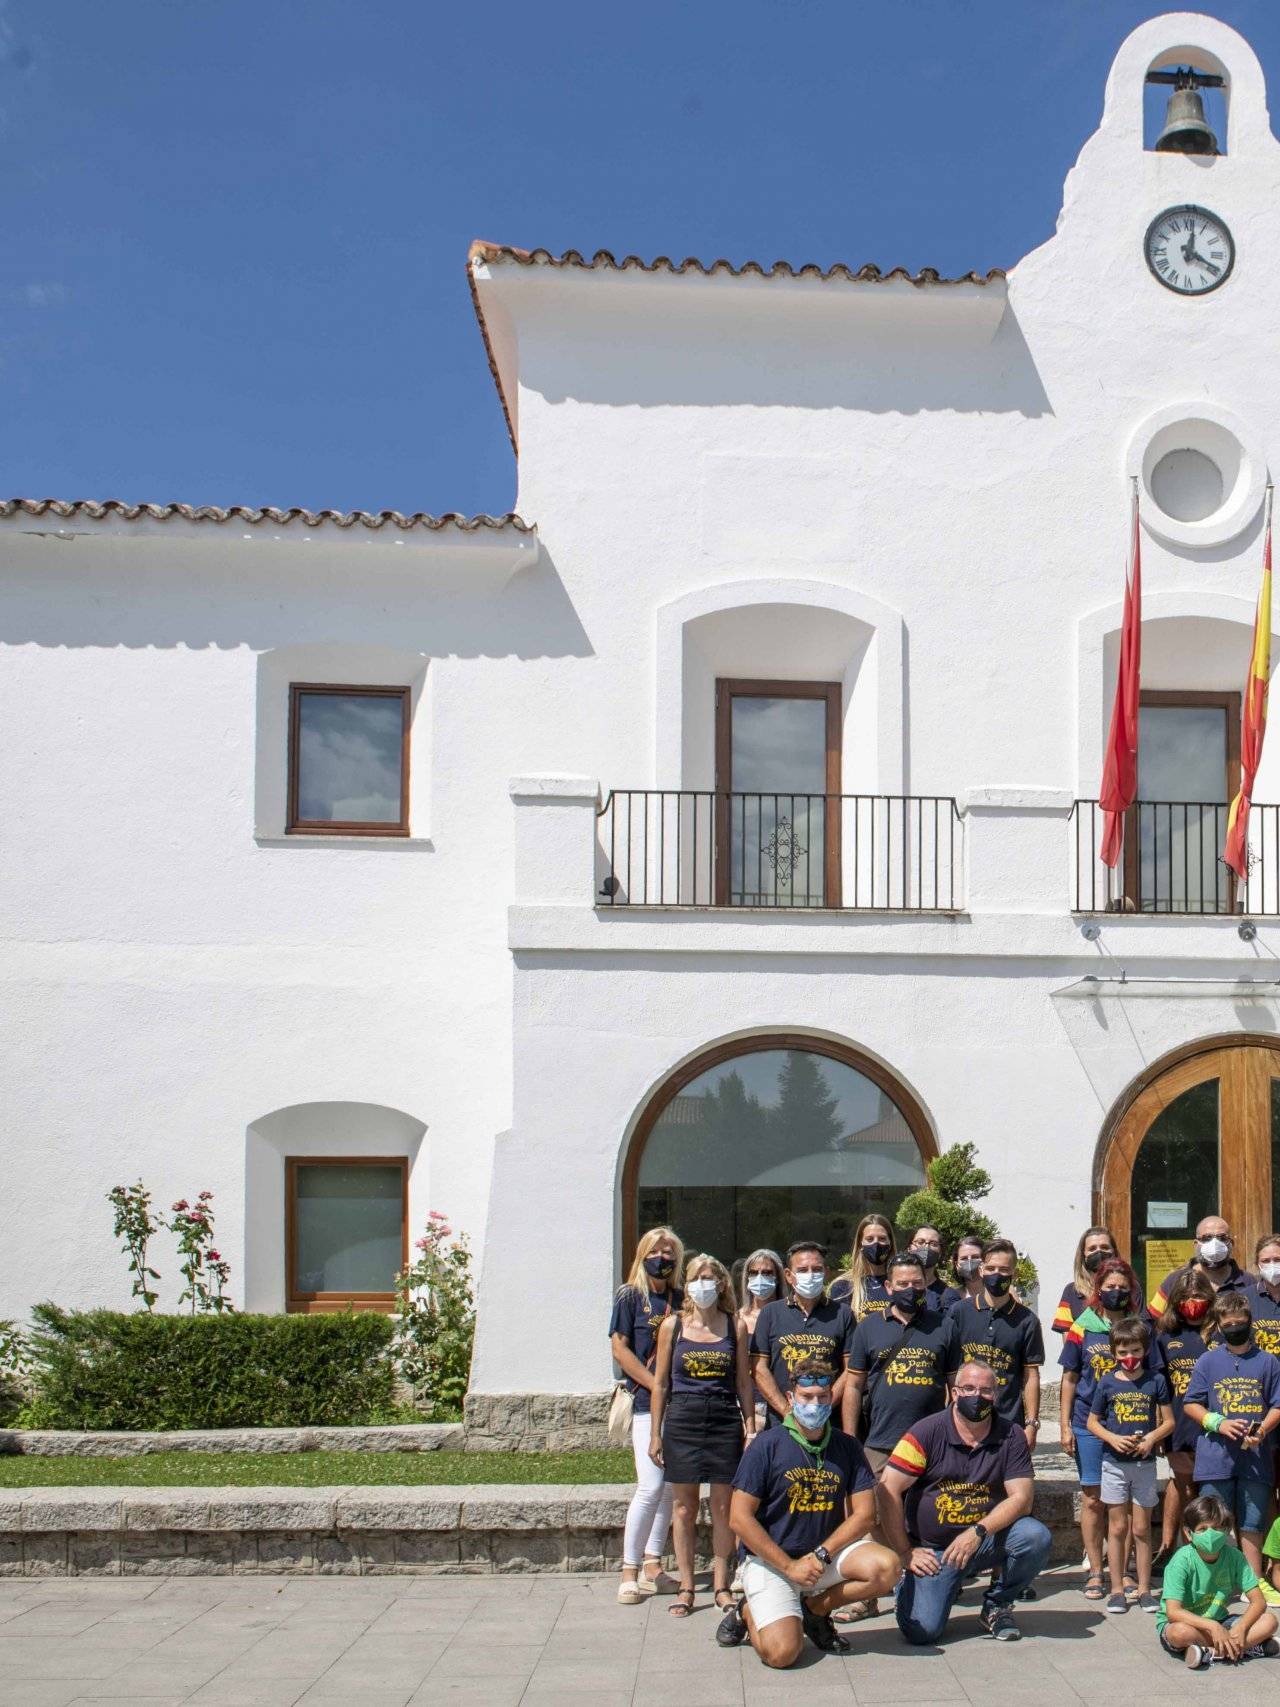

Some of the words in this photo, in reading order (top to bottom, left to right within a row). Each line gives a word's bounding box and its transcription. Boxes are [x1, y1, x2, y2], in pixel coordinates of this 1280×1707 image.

[1210, 251, 1224, 260] III
[779, 1334, 837, 1347] Villanueva
[894, 1372, 934, 1386] Cucos
[1228, 1401, 1263, 1413] Cucos
[784, 1466, 840, 1483] Villanueva
[796, 1499, 834, 1512] Cucos
